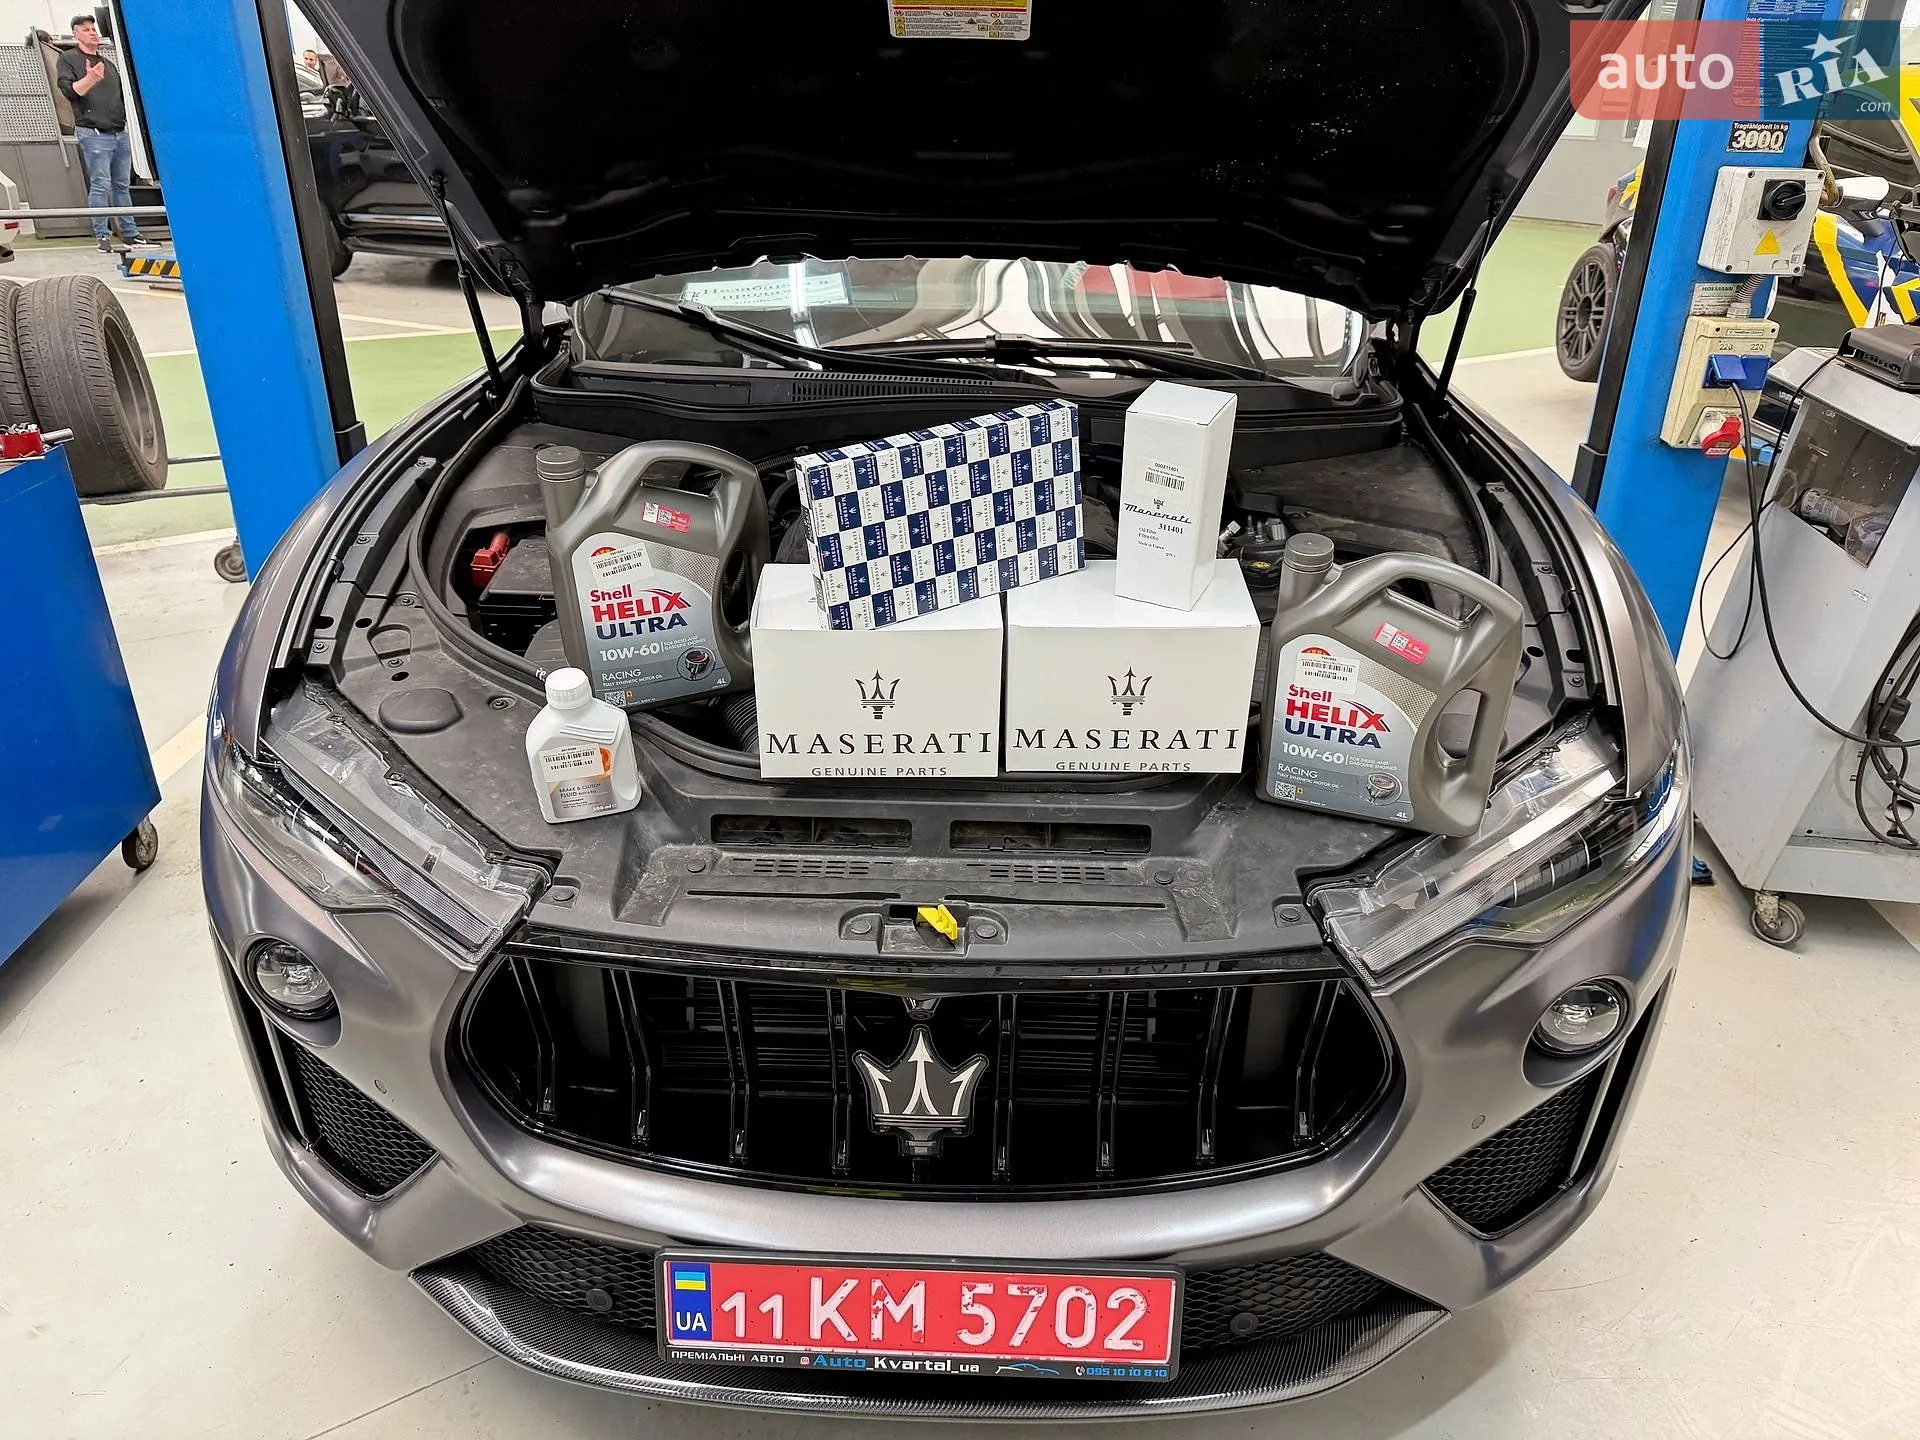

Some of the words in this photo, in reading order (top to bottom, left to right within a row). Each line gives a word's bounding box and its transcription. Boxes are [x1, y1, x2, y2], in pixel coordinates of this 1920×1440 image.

[1732, 130, 1784, 149] 3000
[1719, 343, 1733, 351] 220
[1750, 343, 1764, 351] 220
[1124, 503, 1192, 524] Maserati
[1158, 523, 1184, 534] 311401
[590, 584, 633, 603] Shell
[590, 591, 691, 623] HELIX
[596, 612, 689, 640] ULTRA
[600, 642, 660, 662] 10W-60
[601, 669, 642, 682] RACING
[1288, 684, 1332, 702] Shell
[1286, 699, 1391, 732] HELIX
[766, 732, 991, 755] MASERATI
[1014, 728, 1239, 750] MASERATI
[1285, 719, 1382, 749] ULTRA
[1282, 742, 1344, 764] 10W-60
[812, 766, 887, 777] GENUINE
[896, 766, 948, 777] PARTS
[1055, 760, 1134, 771] GENUINE
[1140, 761, 1190, 772] PARTS
[1278, 763, 1318, 779] RACING
[1396, 811, 1407, 819] 4L
[676, 1311, 707, 1333] UA
[720, 1292, 786, 1340] 11
[810, 1276, 926, 1343] KM
[955, 1281, 1146, 1351] 5702
[671, 1351, 745, 1362] ПРЕМІАЛЬНІ
[751, 1355, 784, 1363] АВТО
[813, 1354, 980, 1373] Auto_Kvartal_ua
[1086, 1367, 1110, 1376] 095
[1114, 1368, 1125, 1377] 10
[1129, 1368, 1141, 1377] 10
[1143, 1369, 1151, 1377] 8
[1155, 1369, 1168, 1378] 10
